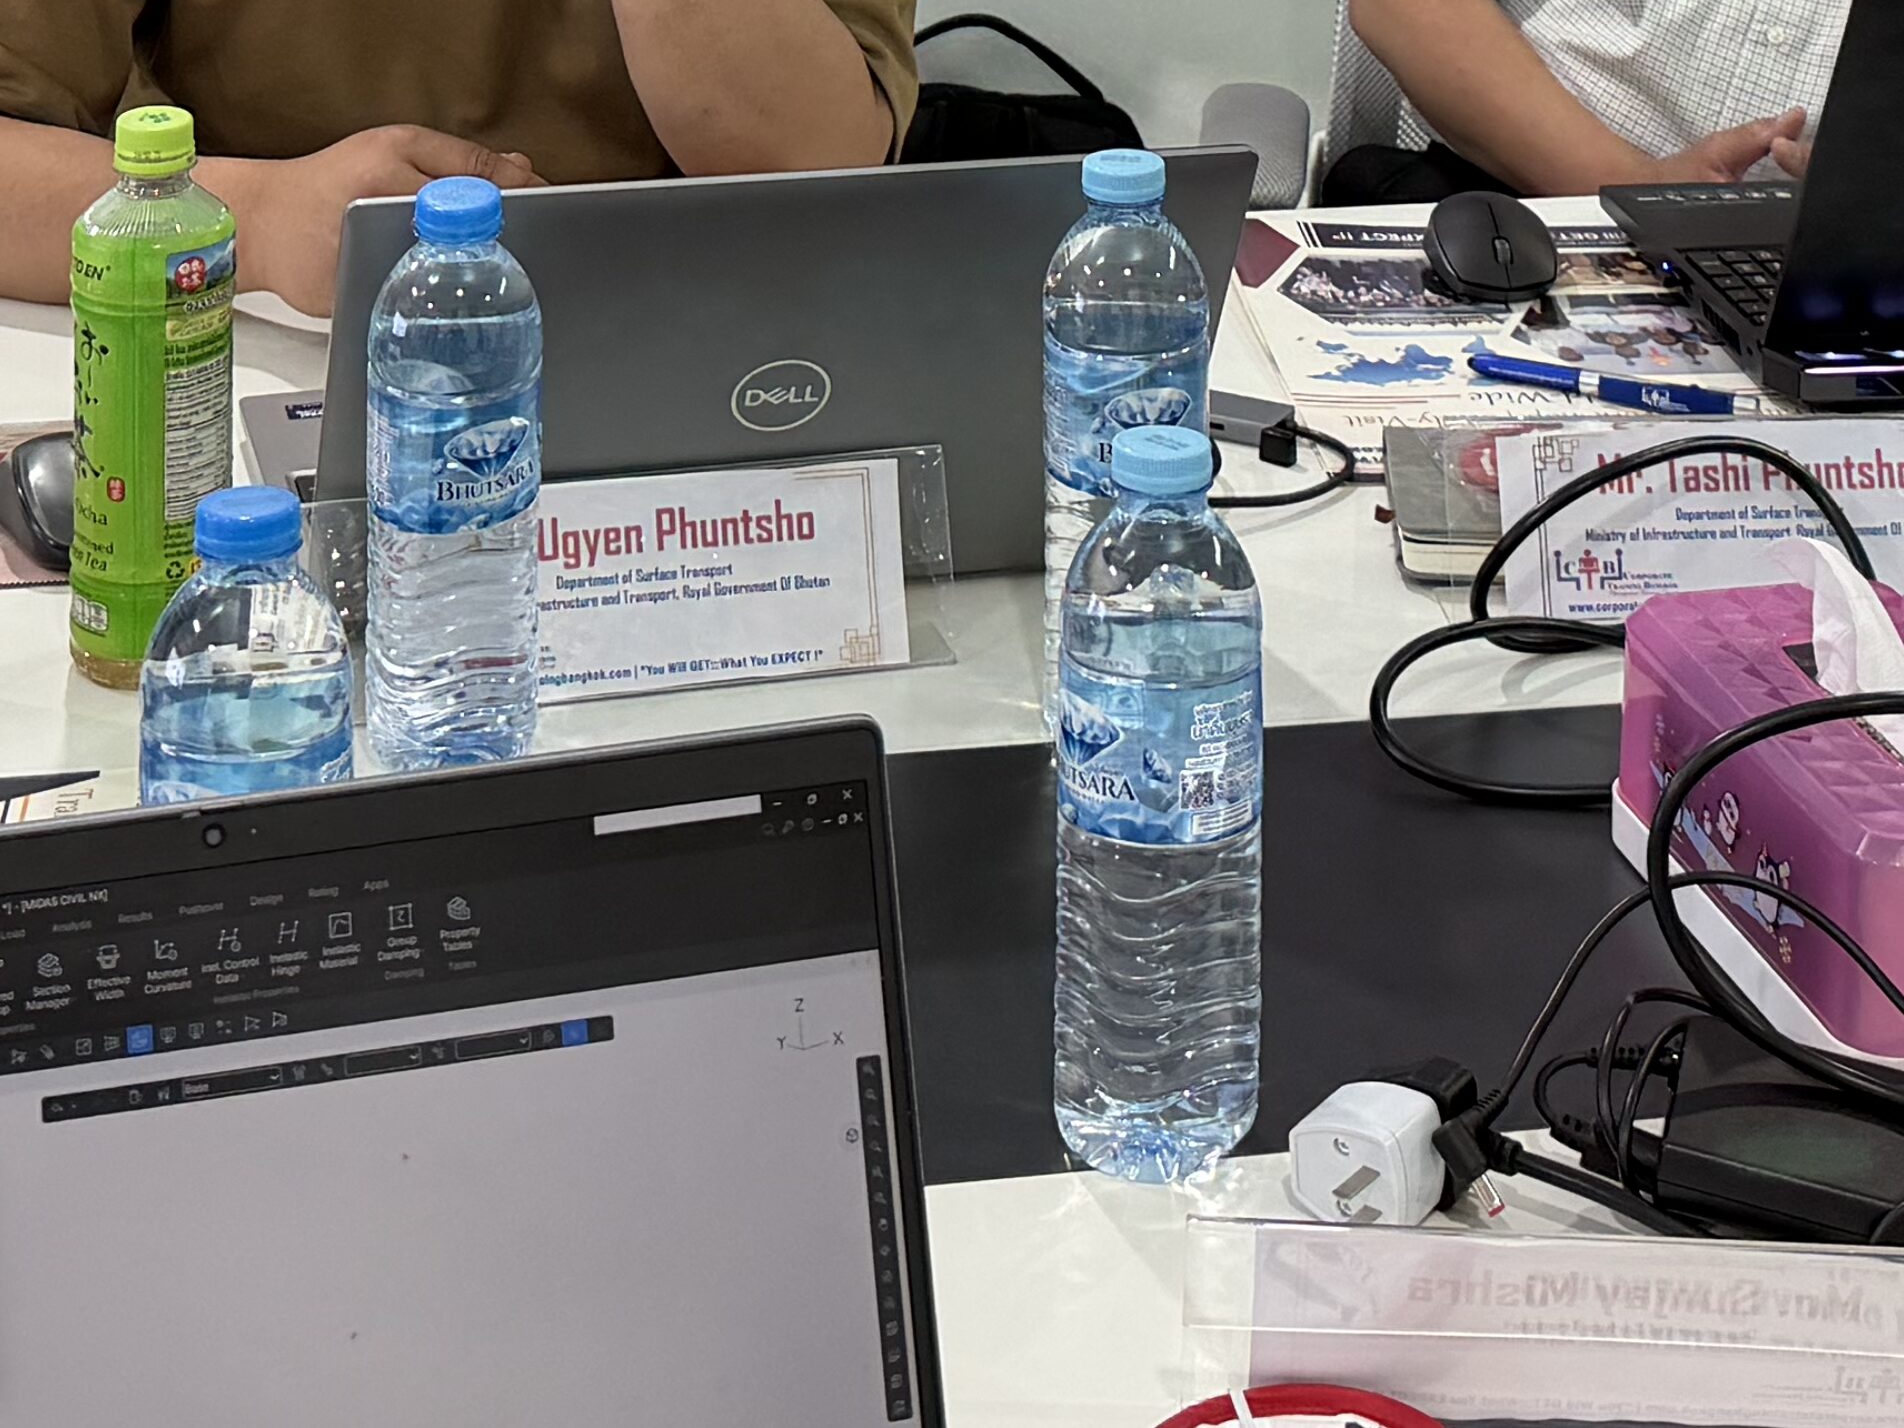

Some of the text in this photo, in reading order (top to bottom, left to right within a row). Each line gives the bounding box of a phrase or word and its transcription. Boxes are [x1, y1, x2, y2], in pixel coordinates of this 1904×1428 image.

[743, 386, 821, 411] DELL
[1667, 450, 1751, 494] Tashi
[1675, 506, 1736, 522] Department
[1751, 506, 1792, 521] Surface
[538, 498, 817, 571] Ugyen Phuntsho
[555, 571, 620, 591] Department
[635, 566, 678, 584] Surface
[680, 562, 733, 580] Transport
[600, 589, 622, 607] and
[681, 582, 712, 601] Royal
[713, 578, 778, 597] Government
[780, 575, 793, 591] Of
[794, 574, 831, 591] Bhutan
[749, 652, 770, 668] You
[770, 649, 812, 666] EXPECT
